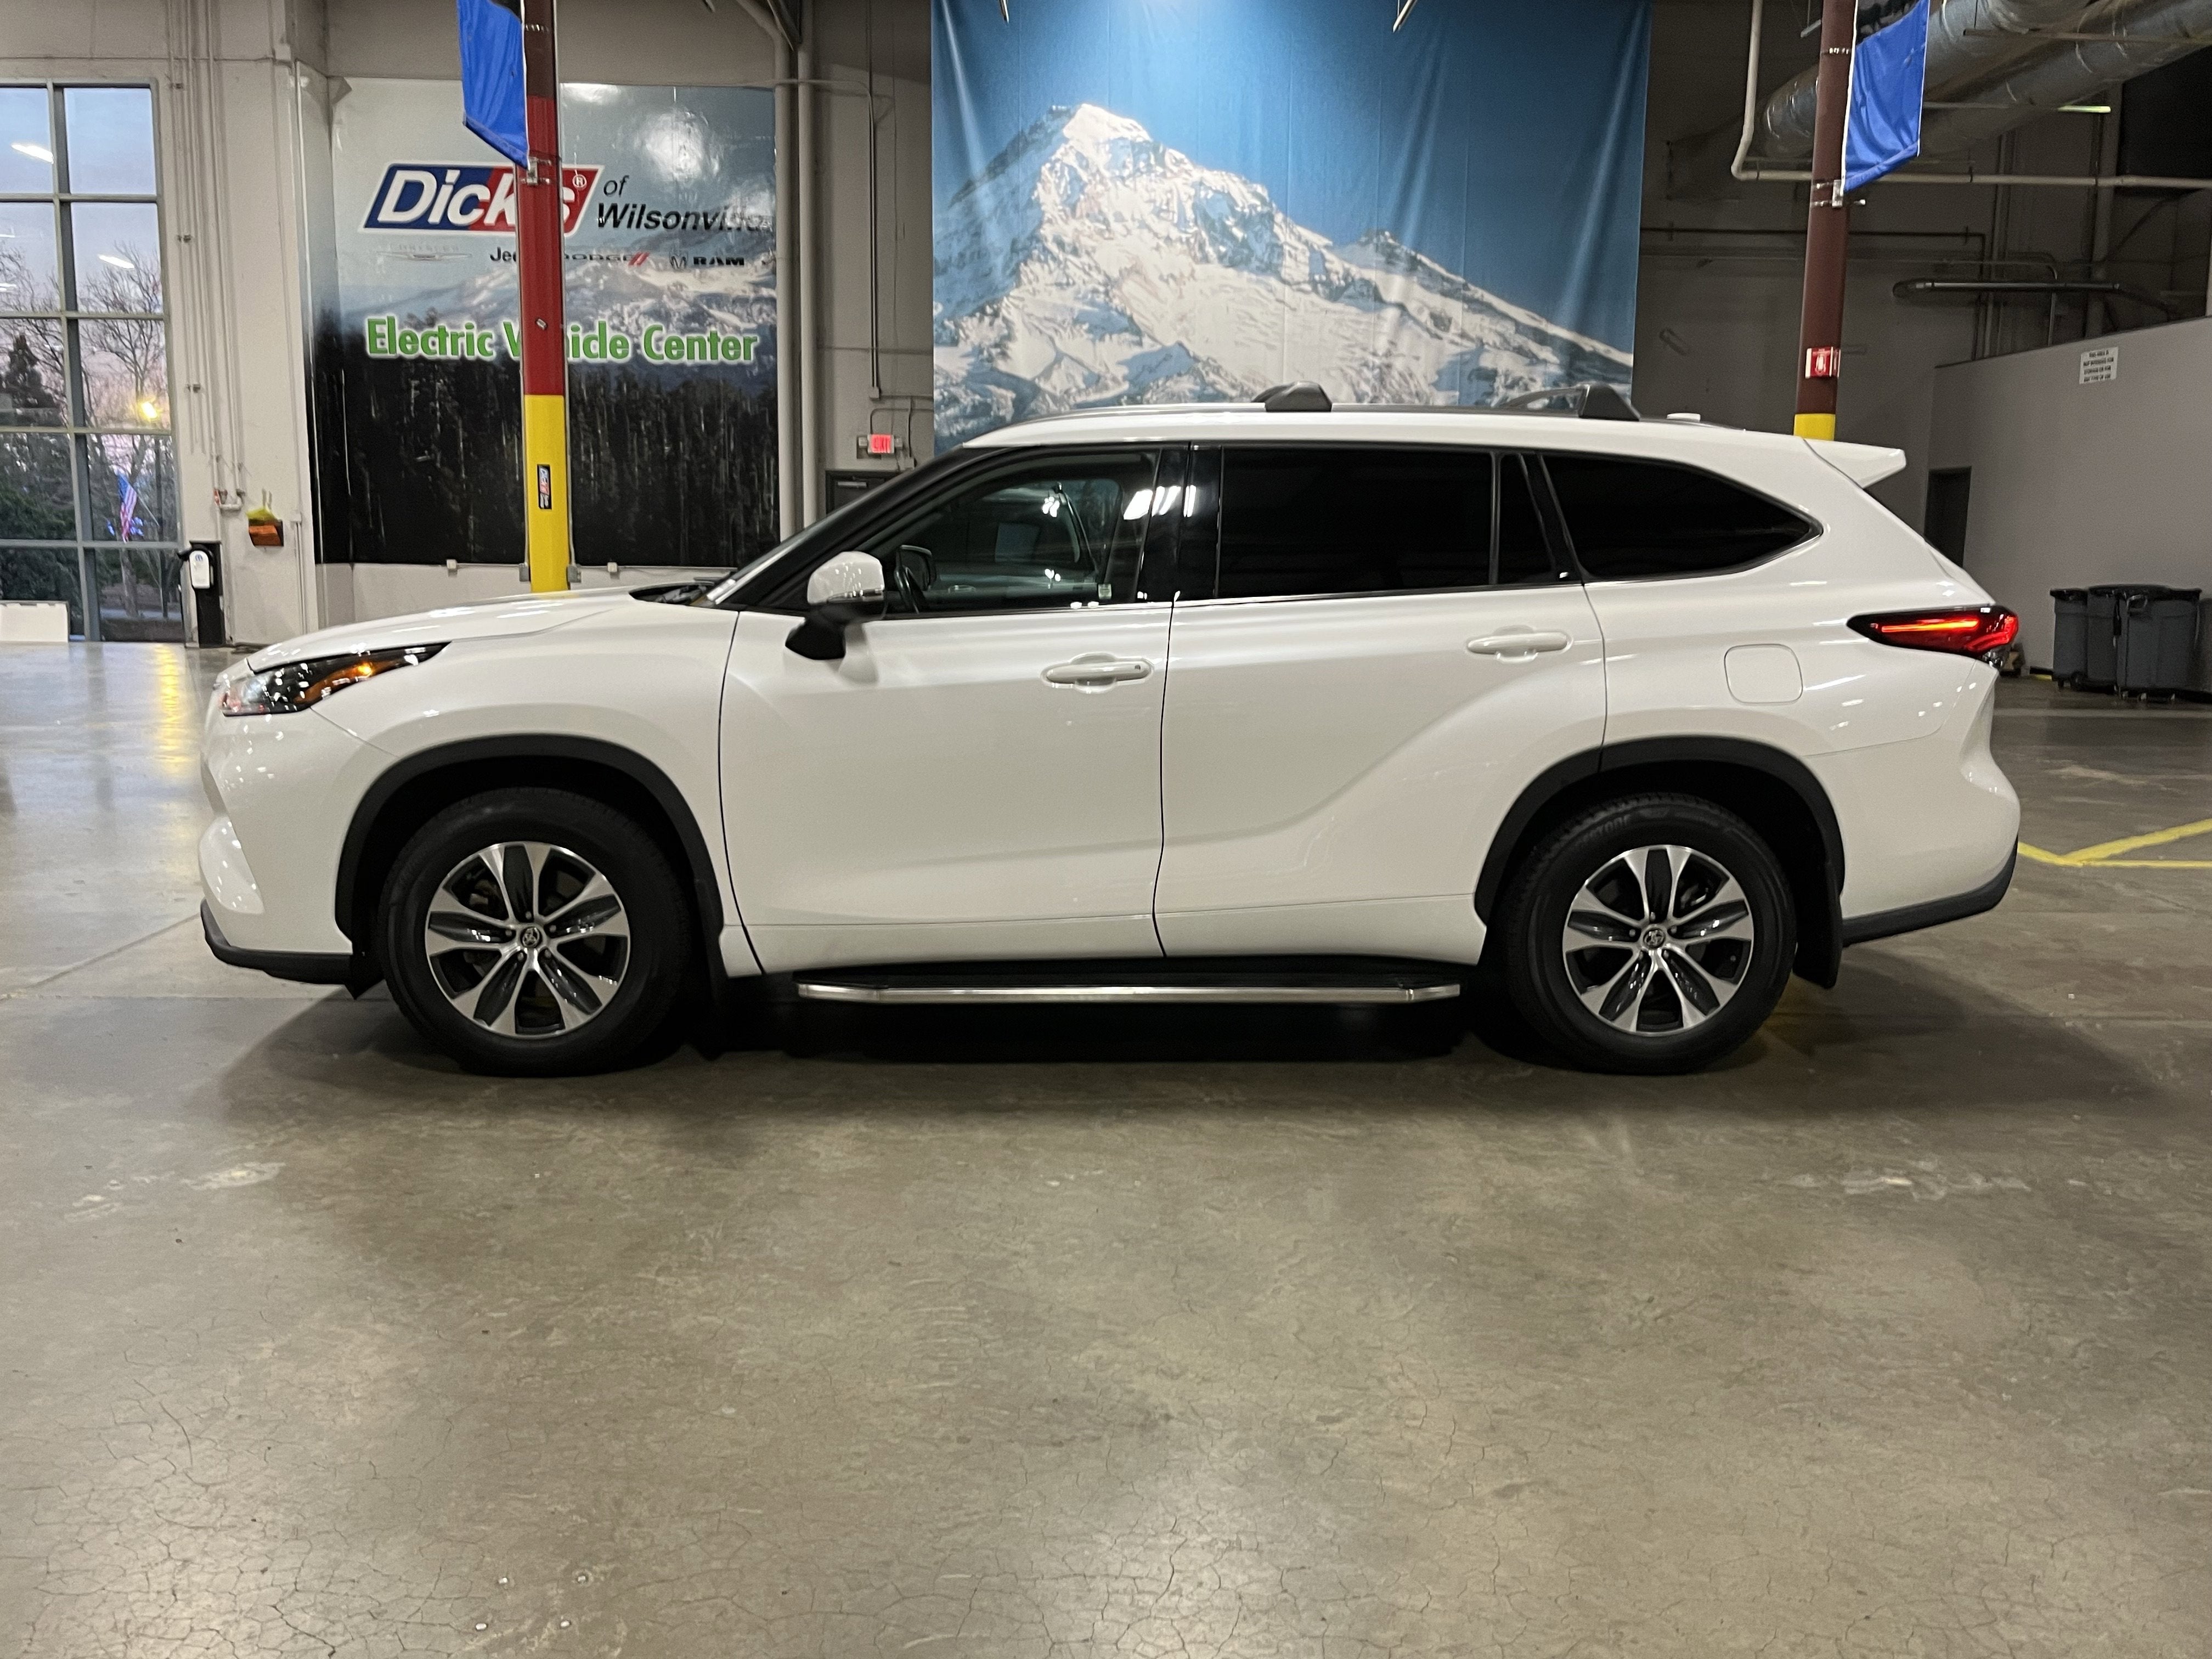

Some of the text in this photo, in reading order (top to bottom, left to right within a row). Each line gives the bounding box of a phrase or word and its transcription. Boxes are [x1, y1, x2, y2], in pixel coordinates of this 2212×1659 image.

[603, 175, 629, 197] of
[693, 256, 744, 266] RAM
[368, 316, 758, 360] Electric Vicle Center
